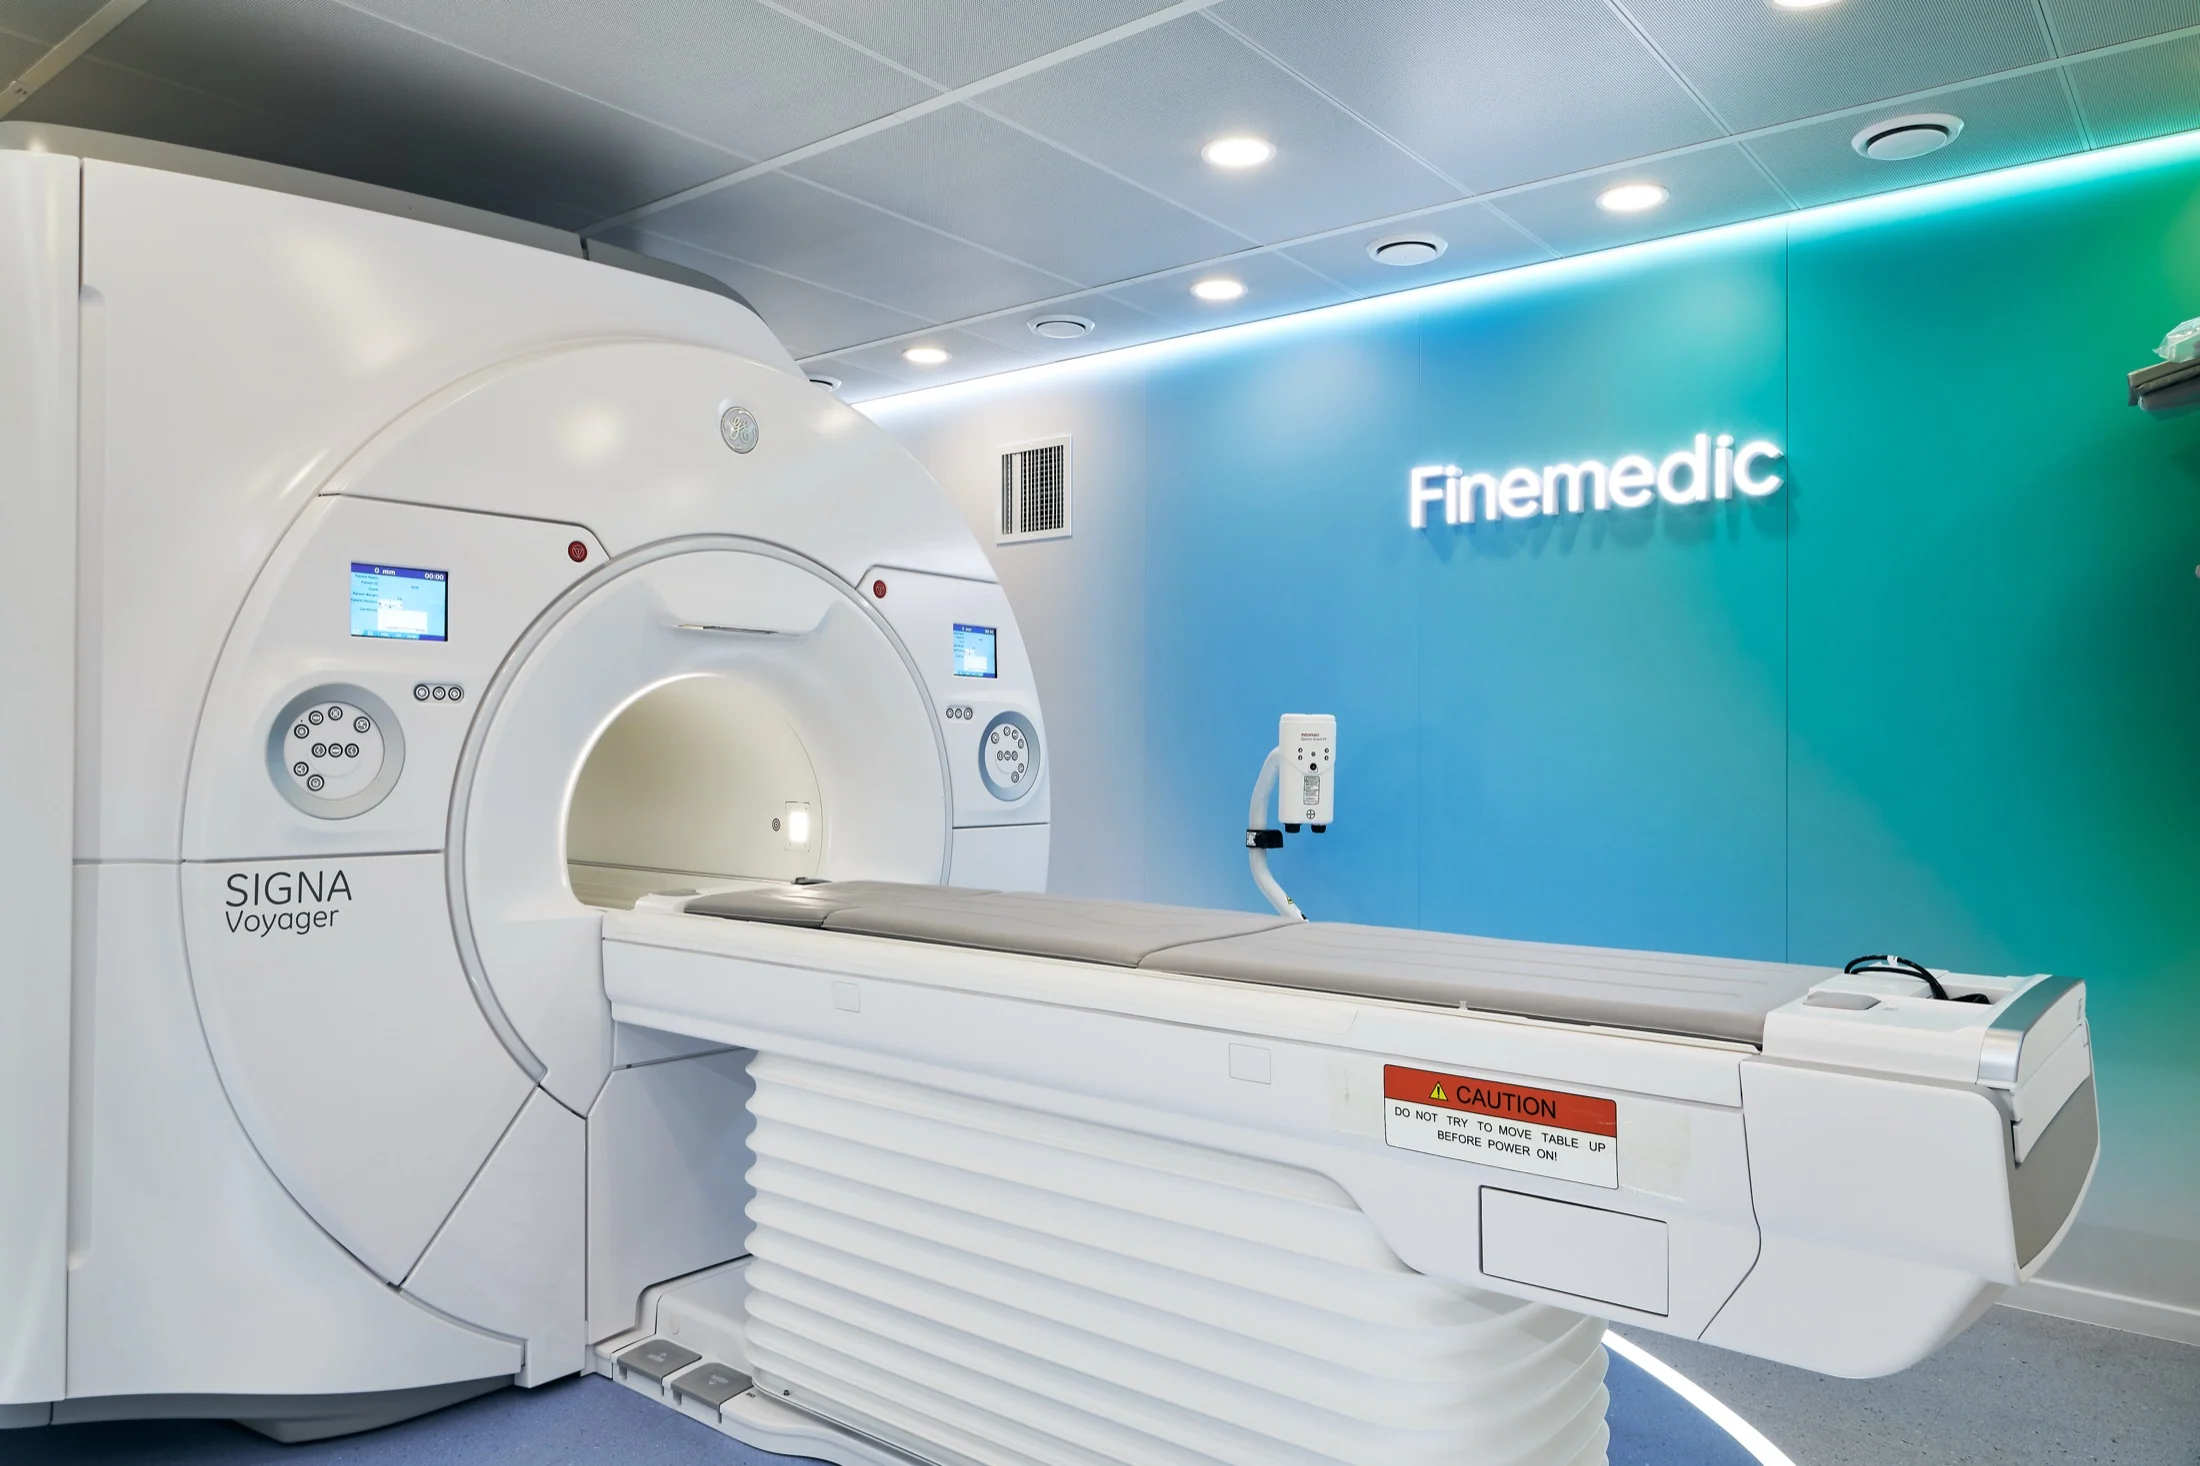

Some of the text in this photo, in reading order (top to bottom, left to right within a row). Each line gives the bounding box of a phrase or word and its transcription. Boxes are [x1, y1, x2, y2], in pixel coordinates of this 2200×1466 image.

[1410, 432, 1785, 529] Finemedic
[424, 572, 444, 580] 00:00
[225, 869, 352, 907] SIGNA
[225, 909, 339, 938] Voyager
[1456, 1085, 1556, 1119] CAUTION
[1394, 1106, 1606, 1153] DO NOT TRY TO MOVE TABLE UP
[1437, 1130, 1558, 1161] BEFORE POWER ON!
